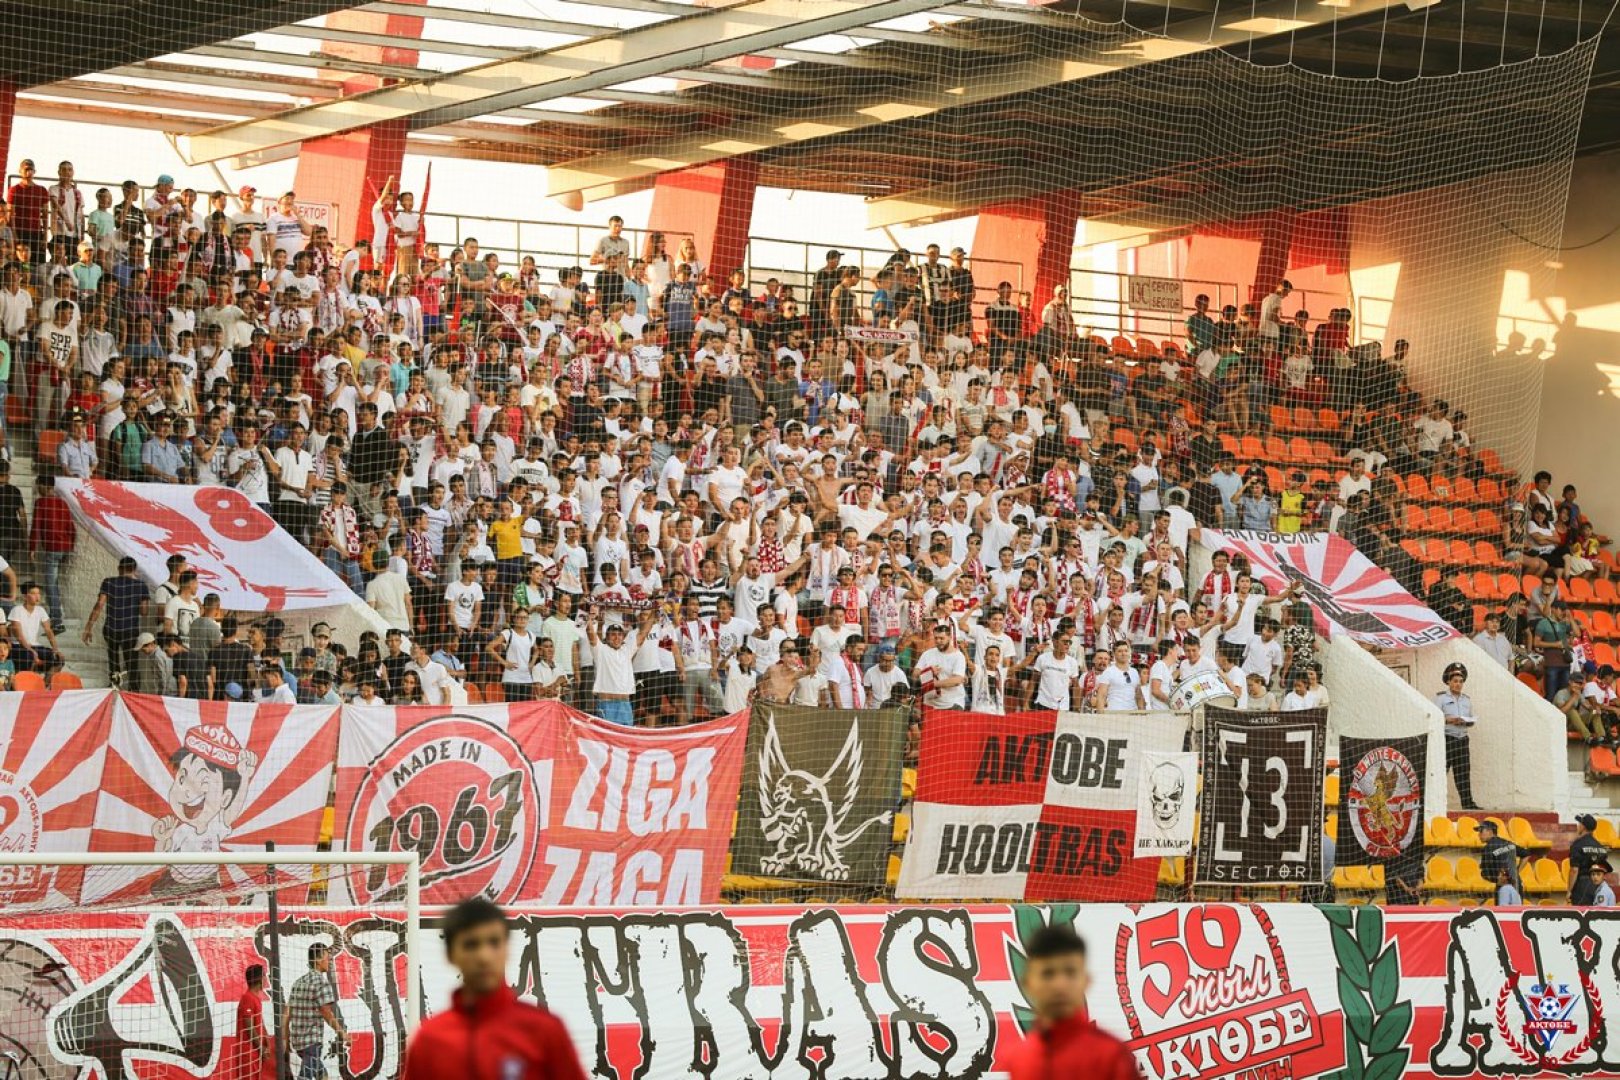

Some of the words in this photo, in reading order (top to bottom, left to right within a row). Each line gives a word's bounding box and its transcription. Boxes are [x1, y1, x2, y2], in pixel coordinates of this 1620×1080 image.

[299, 206, 327, 219] ЕКТОР
[392, 740, 451, 788] MADE
[459, 741, 482, 763] IN
[563, 737, 717, 837] ZIGA
[973, 731, 1128, 789] AKTOBE
[1239, 756, 1289, 839] 13
[366, 770, 523, 891] 1967
[935, 822, 1127, 877] HOOLTRAS
[540, 845, 705, 906] ZAGA
[1214, 864, 1307, 880] SECTOR
[1136, 904, 1241, 1019] 50
